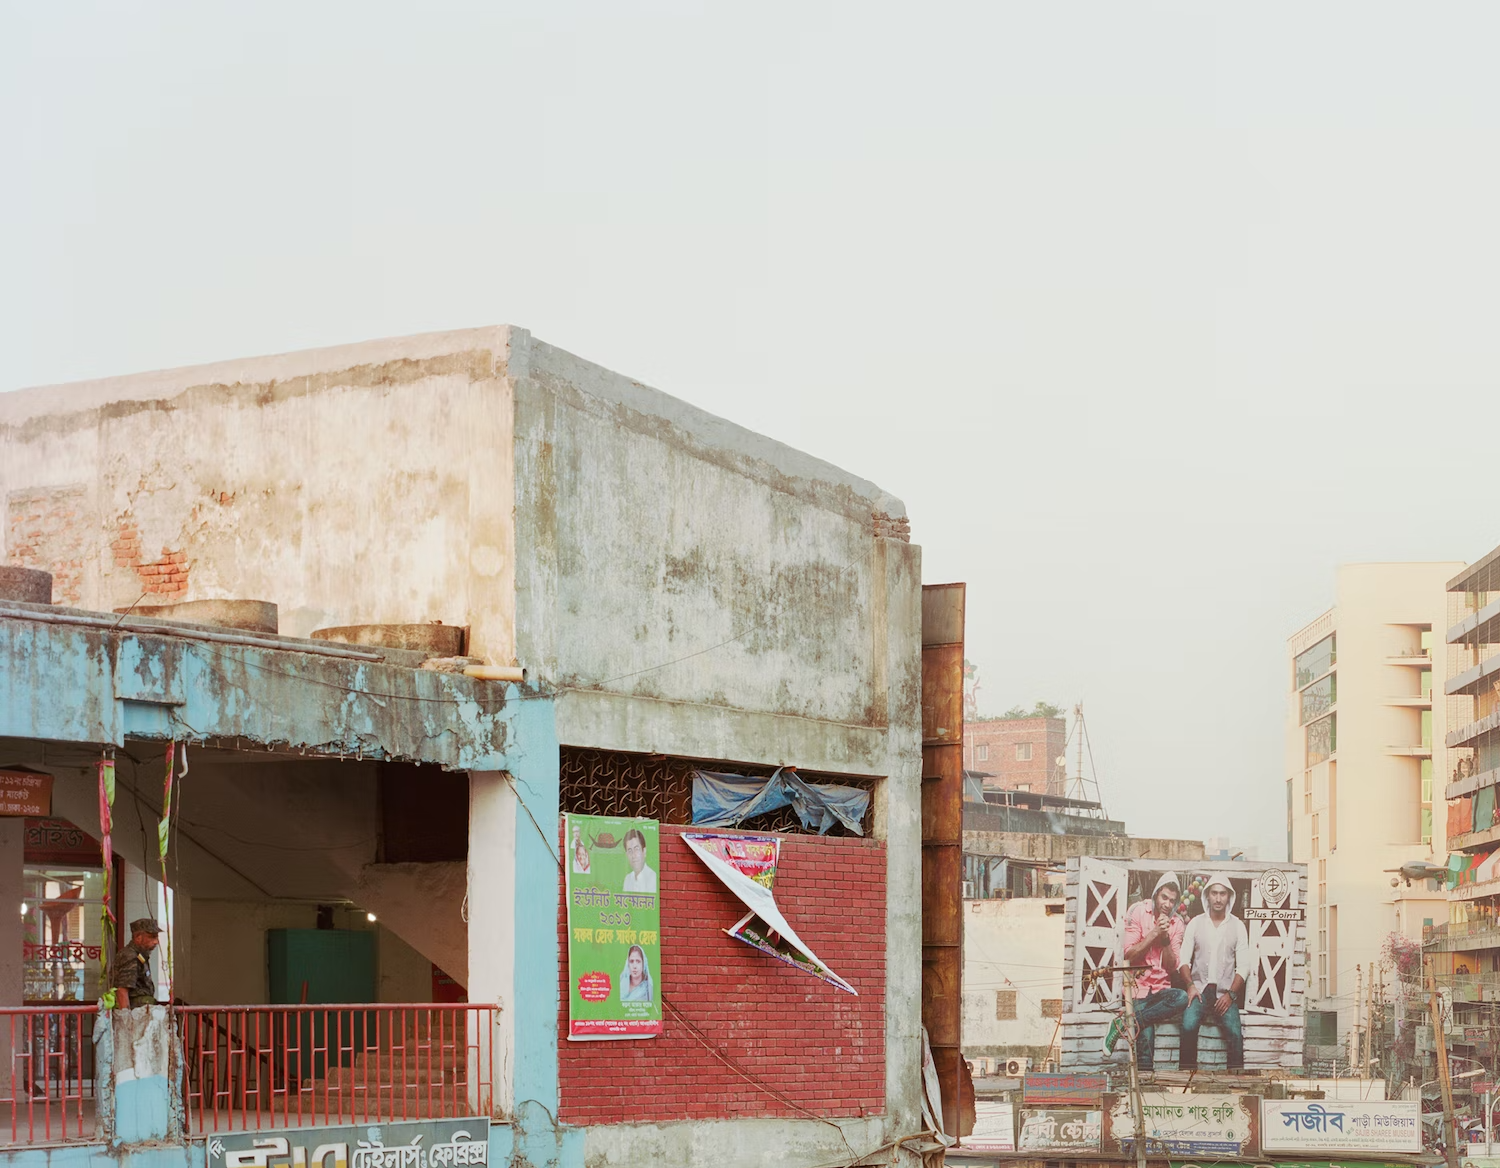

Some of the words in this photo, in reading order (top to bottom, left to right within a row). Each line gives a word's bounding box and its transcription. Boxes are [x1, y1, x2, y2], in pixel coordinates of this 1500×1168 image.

[573, 886, 611, 908] ইউনিট
[599, 911, 632, 926] ২০১৩
[1246, 910, 1267, 919] Plus
[1271, 910, 1298, 919] Point
[1143, 1104, 1184, 1121] আমানত
[1280, 1104, 1346, 1134] সজীব
[1352, 1114, 1371, 1129] শাড়ী
[1374, 1114, 1415, 1128] মিউজিয়াম
[1355, 1129, 1370, 1137] SAJIB
